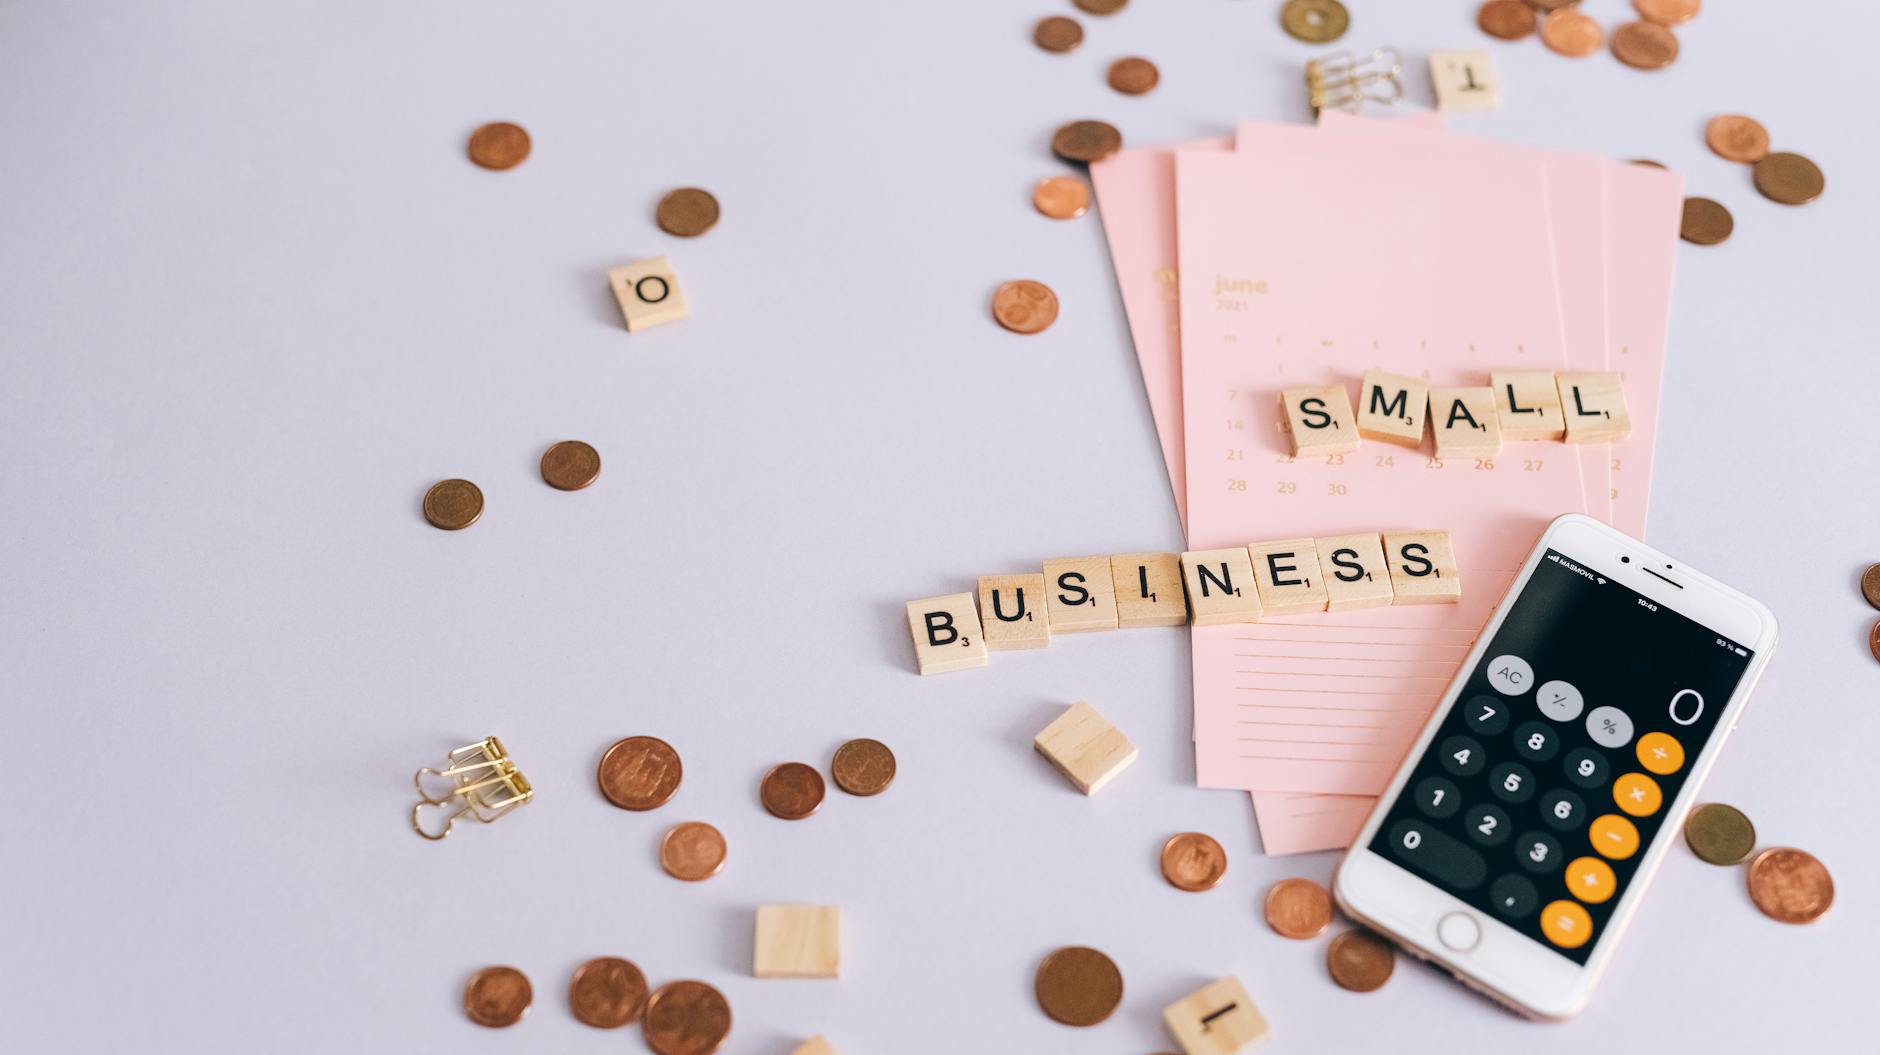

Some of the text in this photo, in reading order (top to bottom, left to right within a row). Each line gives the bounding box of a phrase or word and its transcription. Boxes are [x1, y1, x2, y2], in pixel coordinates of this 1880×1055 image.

[1215, 274, 1269, 295] june
[1299, 384, 1602, 430] SMALL
[1226, 419, 1244, 430] 14
[1225, 450, 1243, 461] 21
[1326, 453, 1344, 465] 23
[1375, 456, 1394, 468] 24
[1474, 459, 1494, 471] 26
[1523, 460, 1543, 472] 27
[1227, 480, 1347, 496] 28 29 30
[1559, 558, 1595, 581] MASMOVIL
[924, 543, 1433, 647] BUSINESS
[1637, 598, 1658, 612] 10:43
[1497, 667, 1523, 684] AC
[1668, 688, 1704, 726] 0
[1478, 705, 1496, 722] 7
[1527, 733, 1545, 750] 8
[1577, 759, 1595, 777] 9
[1453, 748, 1471, 766] 4
[1503, 773, 1522, 792] 5
[1554, 800, 1573, 820] 6
[1432, 789, 1445, 807] 1
[1478, 815, 1498, 836] 2
[1529, 842, 1549, 863] 3
[1403, 830, 1422, 849] 0
